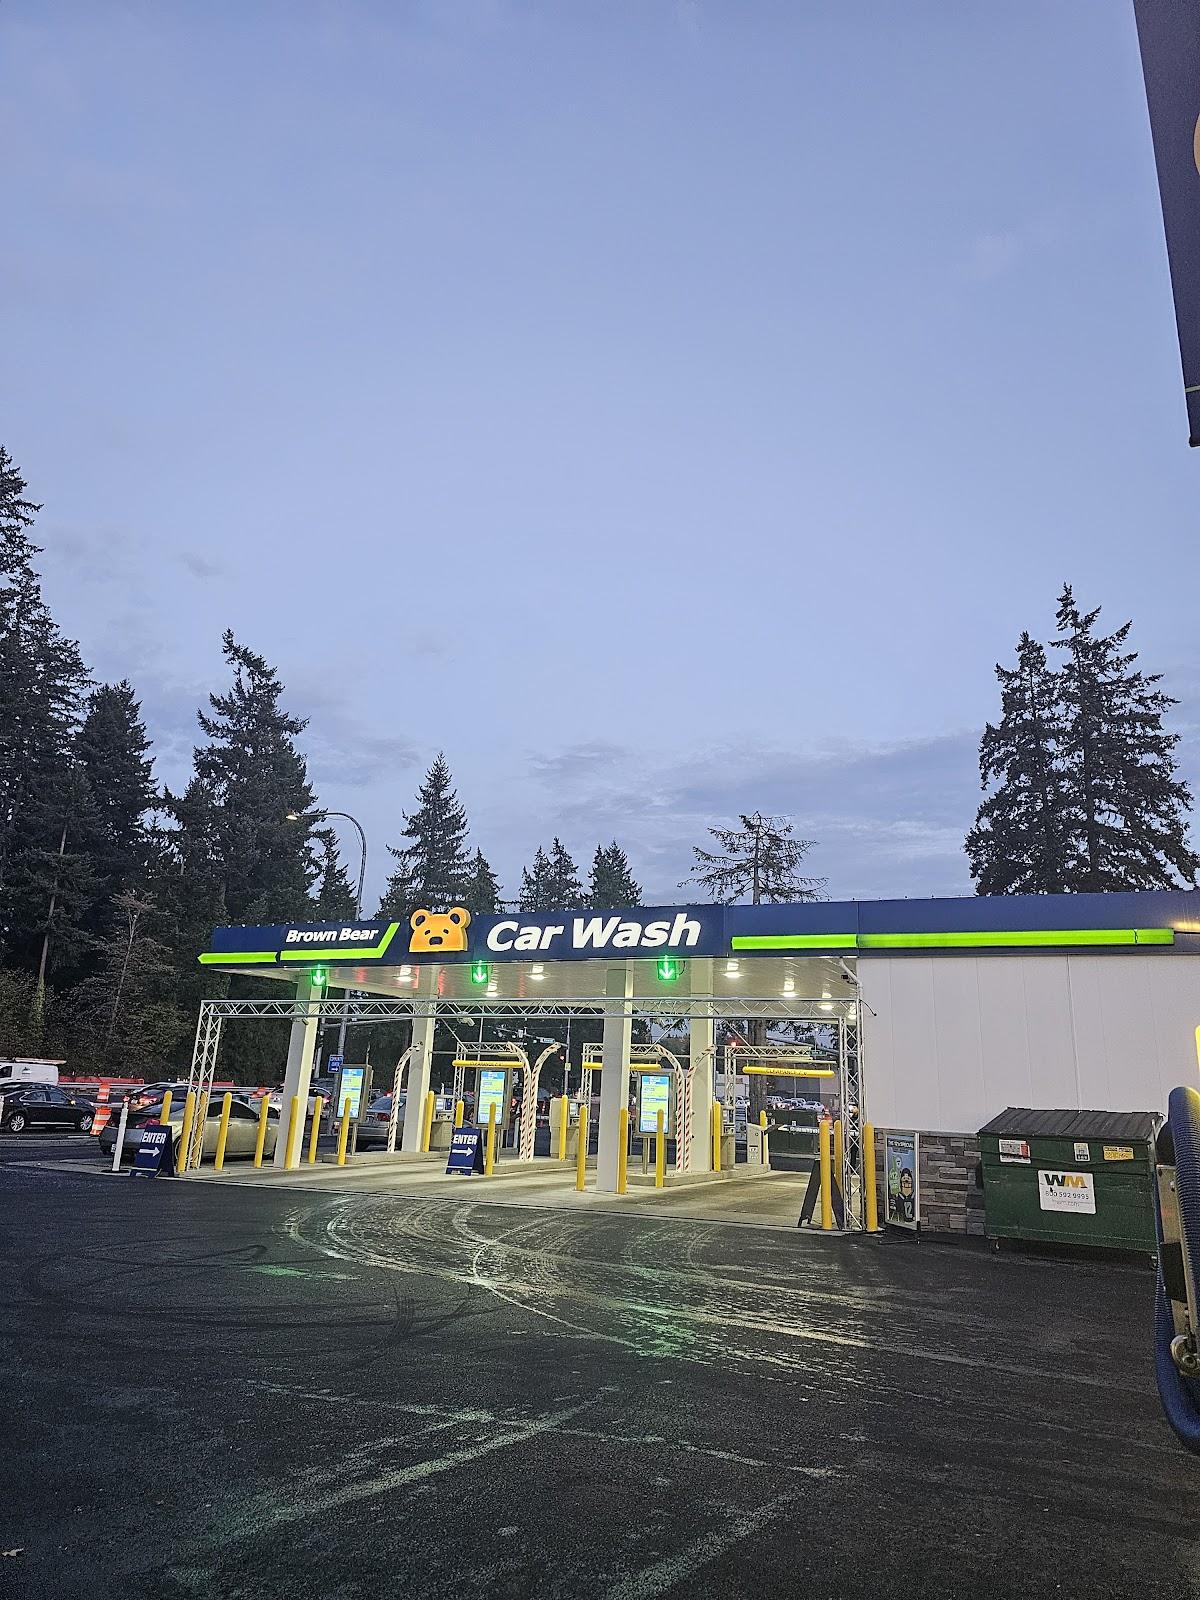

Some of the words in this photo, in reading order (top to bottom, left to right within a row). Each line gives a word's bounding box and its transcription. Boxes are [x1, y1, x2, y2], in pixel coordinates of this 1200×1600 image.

[286, 929, 337, 942] Brown
[338, 927, 379, 940] Bear
[486, 920, 564, 951] Car
[572, 913, 701, 949] Wash
[141, 1132, 167, 1144] ENTER
[453, 1134, 478, 1145] ENTER
[1044, 1174, 1087, 1188] WM
